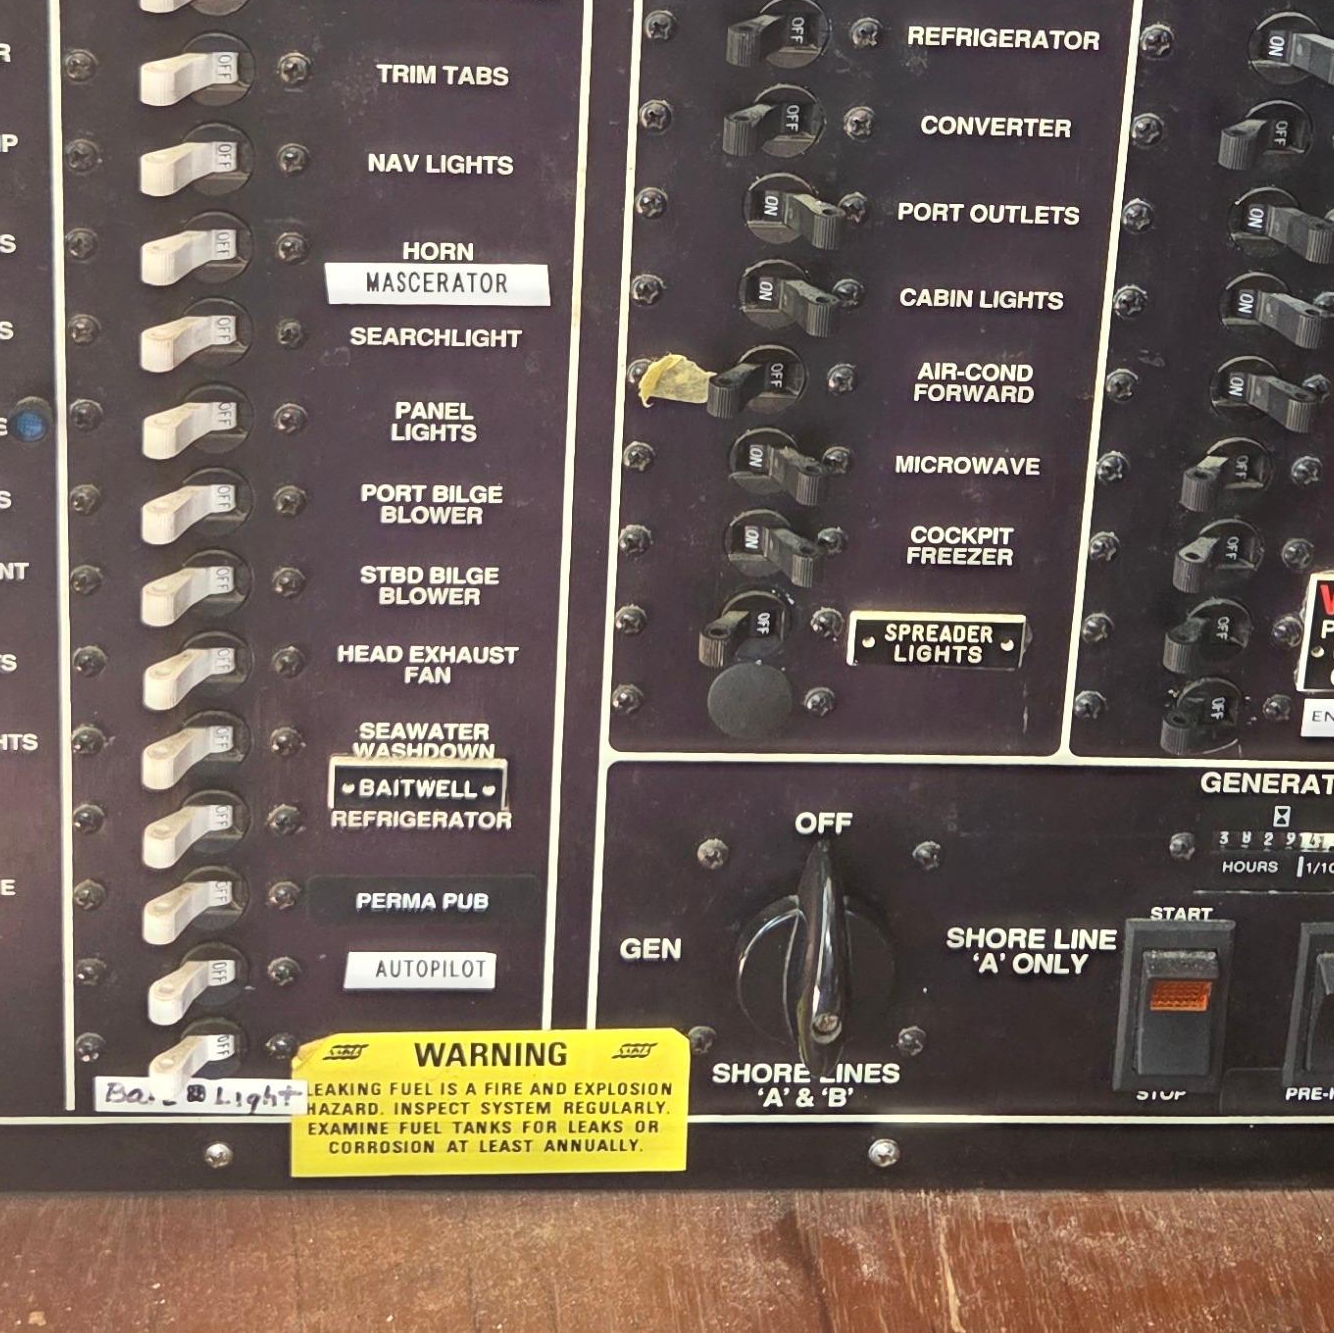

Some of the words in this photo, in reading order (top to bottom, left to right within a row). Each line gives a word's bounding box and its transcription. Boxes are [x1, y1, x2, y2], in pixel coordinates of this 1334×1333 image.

[908, 26, 1099, 50] REFRIGERATOR
[367, 272, 507, 293] MASCERATOR
[351, 327, 522, 347] SEARCHLIGHT
[918, 363, 1033, 381] AIR-COND
[914, 384, 1034, 403] FORWARD
[896, 456, 1040, 475] MICROWAVE
[885, 624, 992, 643] SPREADER
[894, 644, 982, 663] LIGHTS
[360, 779, 477, 798] BAITWELL
[795, 812, 853, 834] OFF
[356, 893, 436, 909] PERMA
[443, 893, 488, 909] PUB
[1151, 907, 1216, 922] START
[620, 938, 681, 959] GEN
[376, 960, 485, 978] AUTOPILOT
[415, 1042, 566, 1067] WARNING
[308, 1083, 381, 1096] LEAKING
[390, 1083, 432, 1095] FUEL
[441, 1083, 457, 1095] IS
[466, 1083, 476, 1095] A
[485, 1082, 522, 1095] FIRE
[530, 1082, 566, 1095] AND
[575, 1083, 671, 1095] EXPLOSION
[395, 1102, 470, 1115] INSPECT
[481, 1102, 550, 1114] SYSTEM
[564, 1101, 670, 1114] REGULARLY.
[309, 1122, 388, 1135] EXAMINE
[400, 1122, 441, 1134] FUEL
[452, 1121, 511, 1134] TANKS
[523, 1121, 556, 1133] FOR
[569, 1121, 622, 1133] LEAKS
[635, 1121, 658, 1133] OR
[329, 1141, 434, 1154] CORROSION
[447, 1140, 468, 1152] AT
[480, 1140, 532, 1152] LEAST
[544, 1139, 644, 1152] ANNUALLY.
